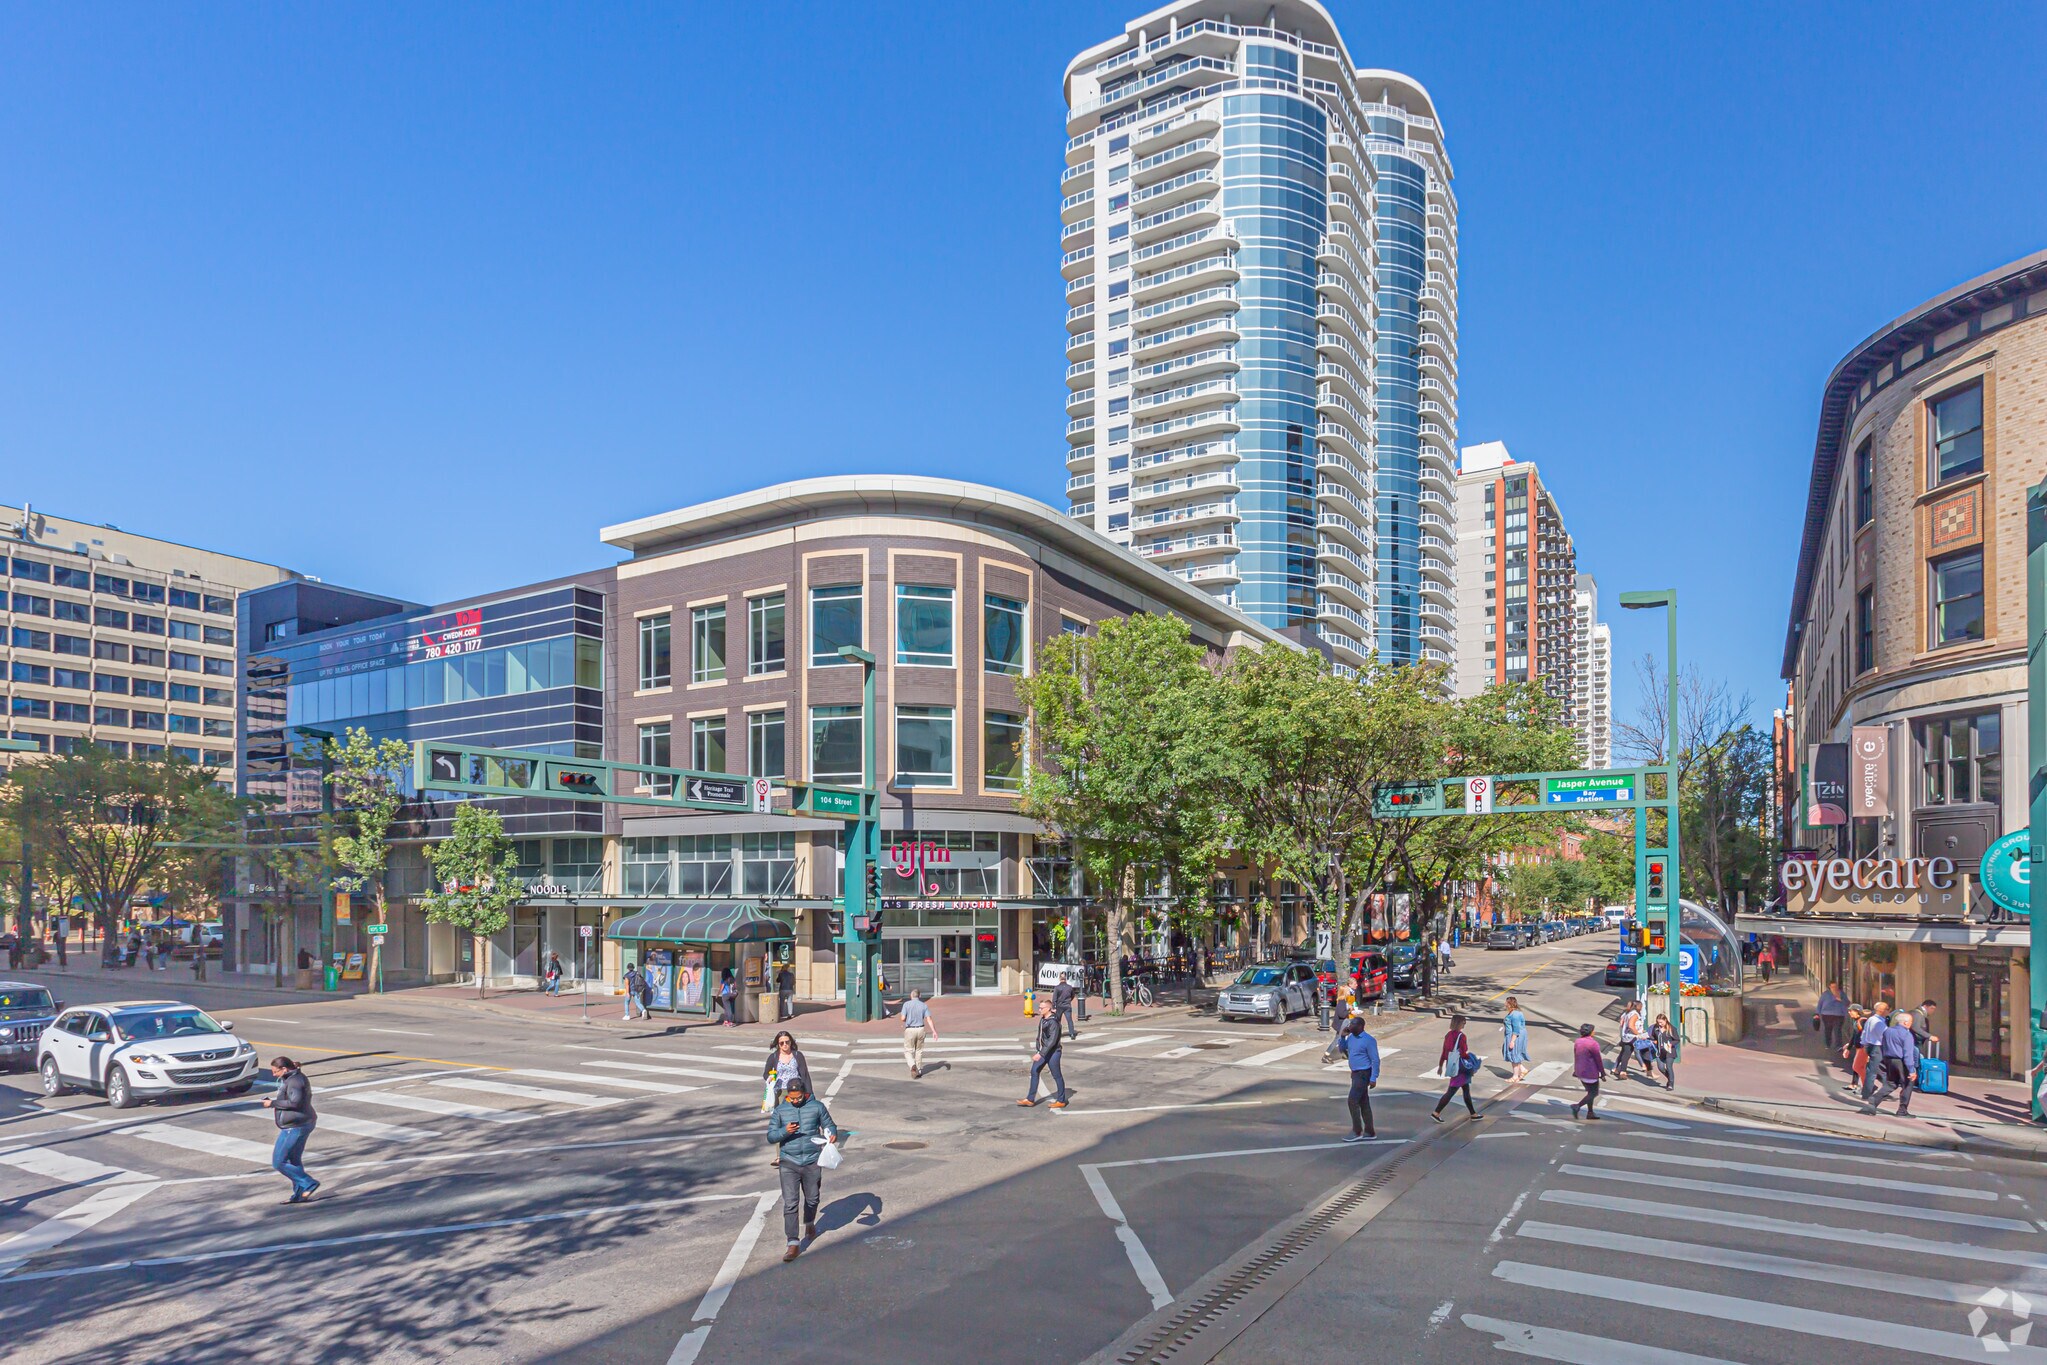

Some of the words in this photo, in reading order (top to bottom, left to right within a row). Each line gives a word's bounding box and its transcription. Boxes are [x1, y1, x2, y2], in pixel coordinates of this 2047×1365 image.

[336, 639, 350, 648] YOUR
[353, 635, 367, 644] TOUR
[369, 631, 386, 641] TODAY
[442, 628, 477, 641] CWEDM.COM
[425, 646, 441, 659] 780
[444, 642, 461, 655] 420
[464, 639, 482, 652] 1177
[351, 661, 369, 671] OFFICE
[369, 659, 386, 668] SPACE
[703, 785, 723, 793] Heritage
[1557, 780, 1587, 789] Jasper
[1589, 778, 1624, 787] Avenue
[1864, 763, 1877, 808] eyecare
[707, 791, 731, 799] Promenade
[1582, 790, 1597, 798] Bay
[820, 796, 832, 804] 104
[834, 797, 853, 806] Street
[890, 841, 951, 897] tiffin
[1782, 857, 1955, 902] eyecare
[530, 885, 568, 895] NOODLE
[1851, 893, 1953, 904] GROUP
[911, 901, 945, 910] FRESH
[953, 901, 997, 909] KITCHEN
[1040, 969, 1059, 979] NOW
[1061, 970, 1082, 981] PEN
